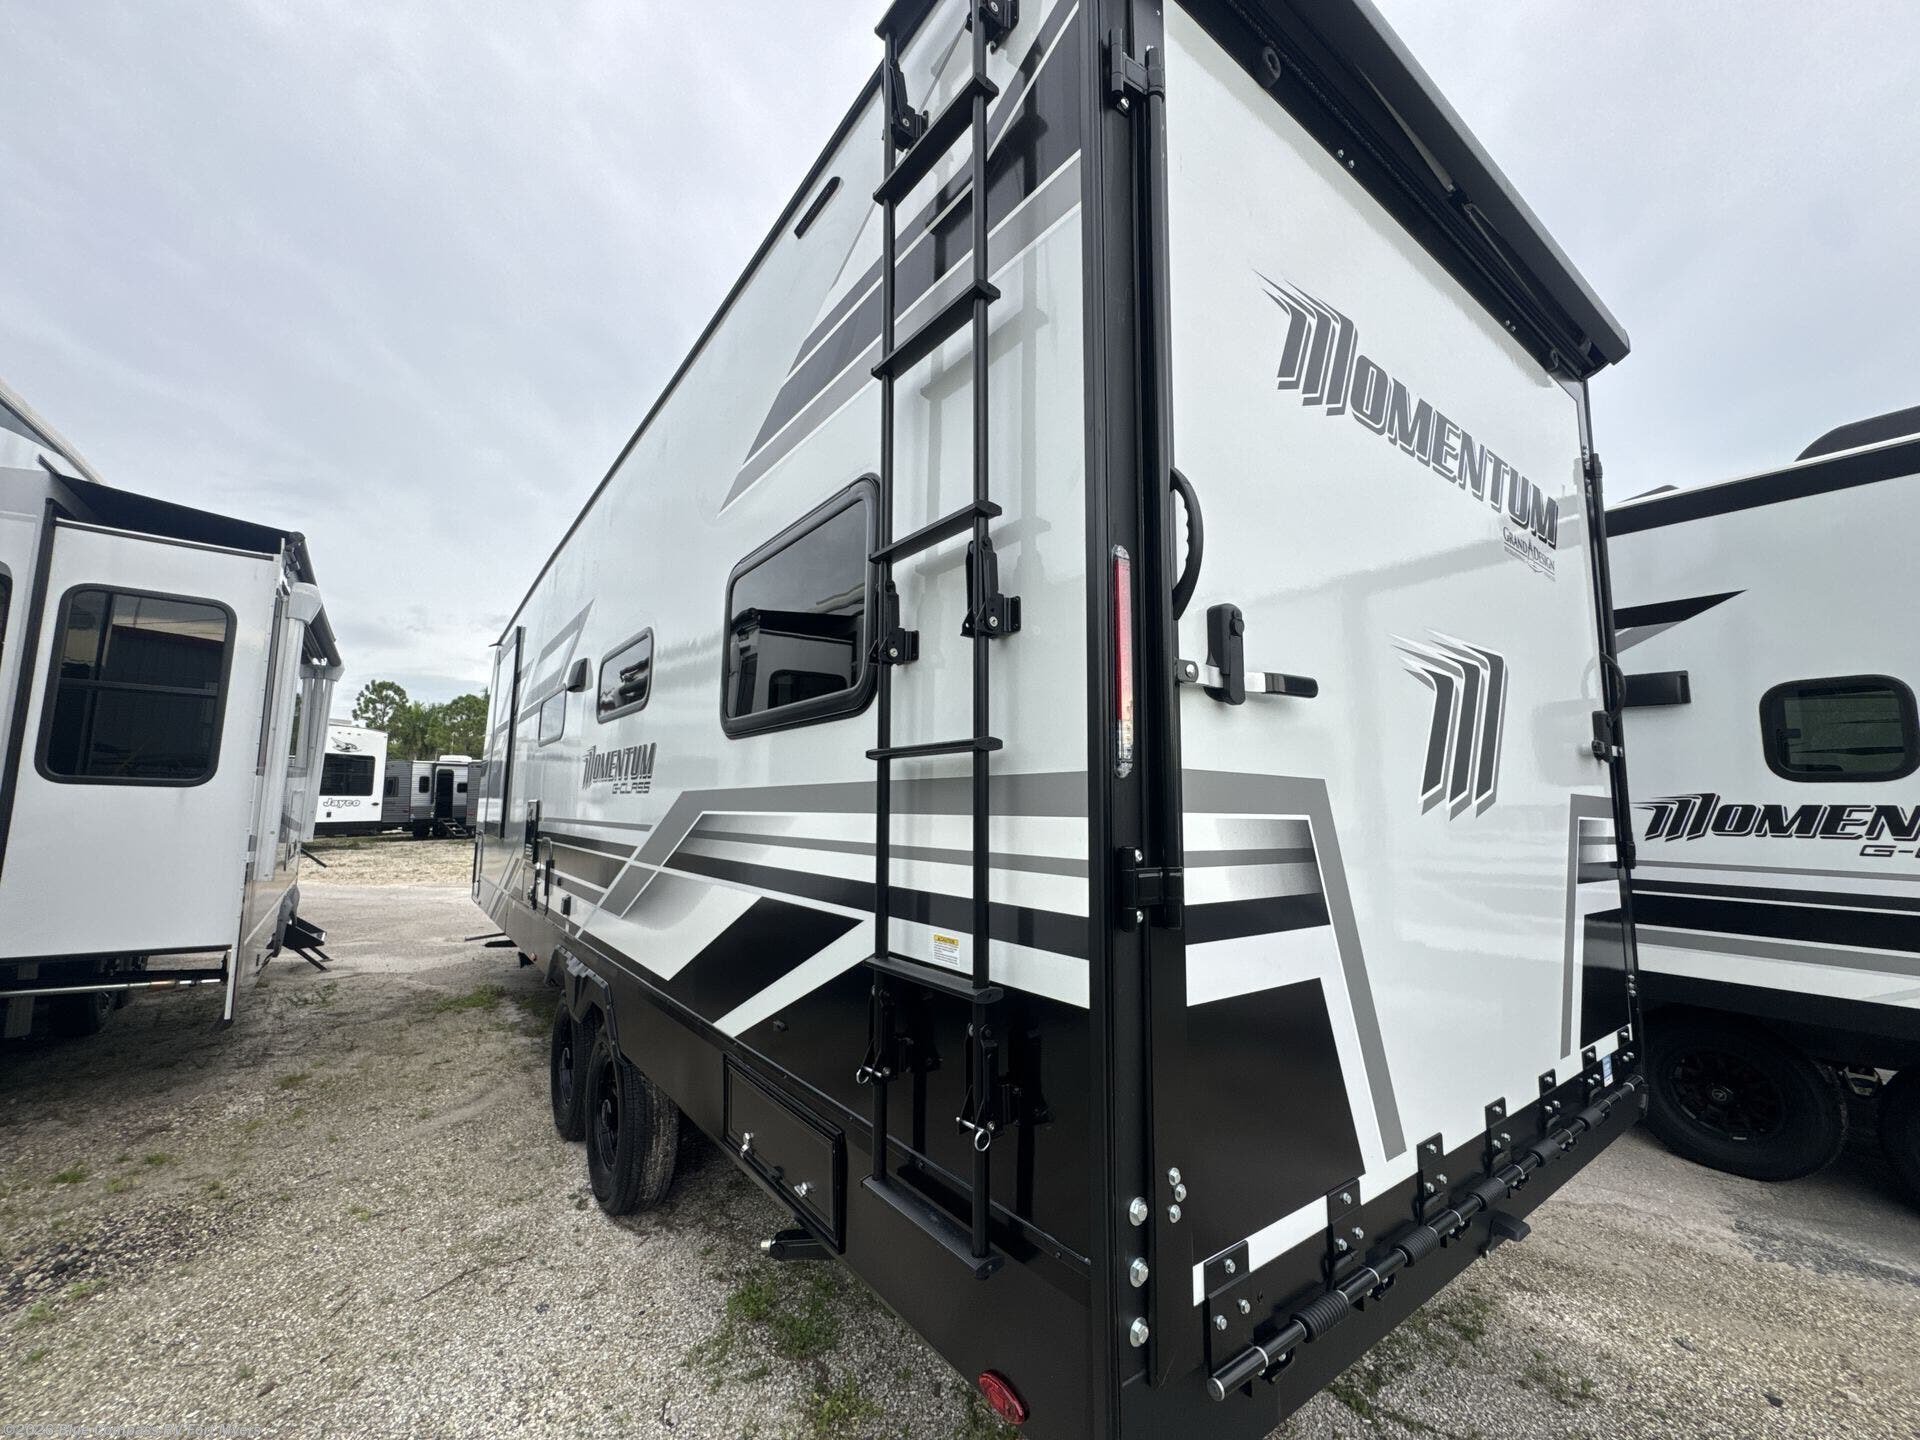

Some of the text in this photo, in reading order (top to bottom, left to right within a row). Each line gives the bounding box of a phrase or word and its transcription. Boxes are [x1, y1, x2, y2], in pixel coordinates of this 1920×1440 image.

[1252, 269, 1559, 550] MOMENTUM
[582, 742, 657, 790] MOMENTUM
[323, 798, 361, 808] Jayco
